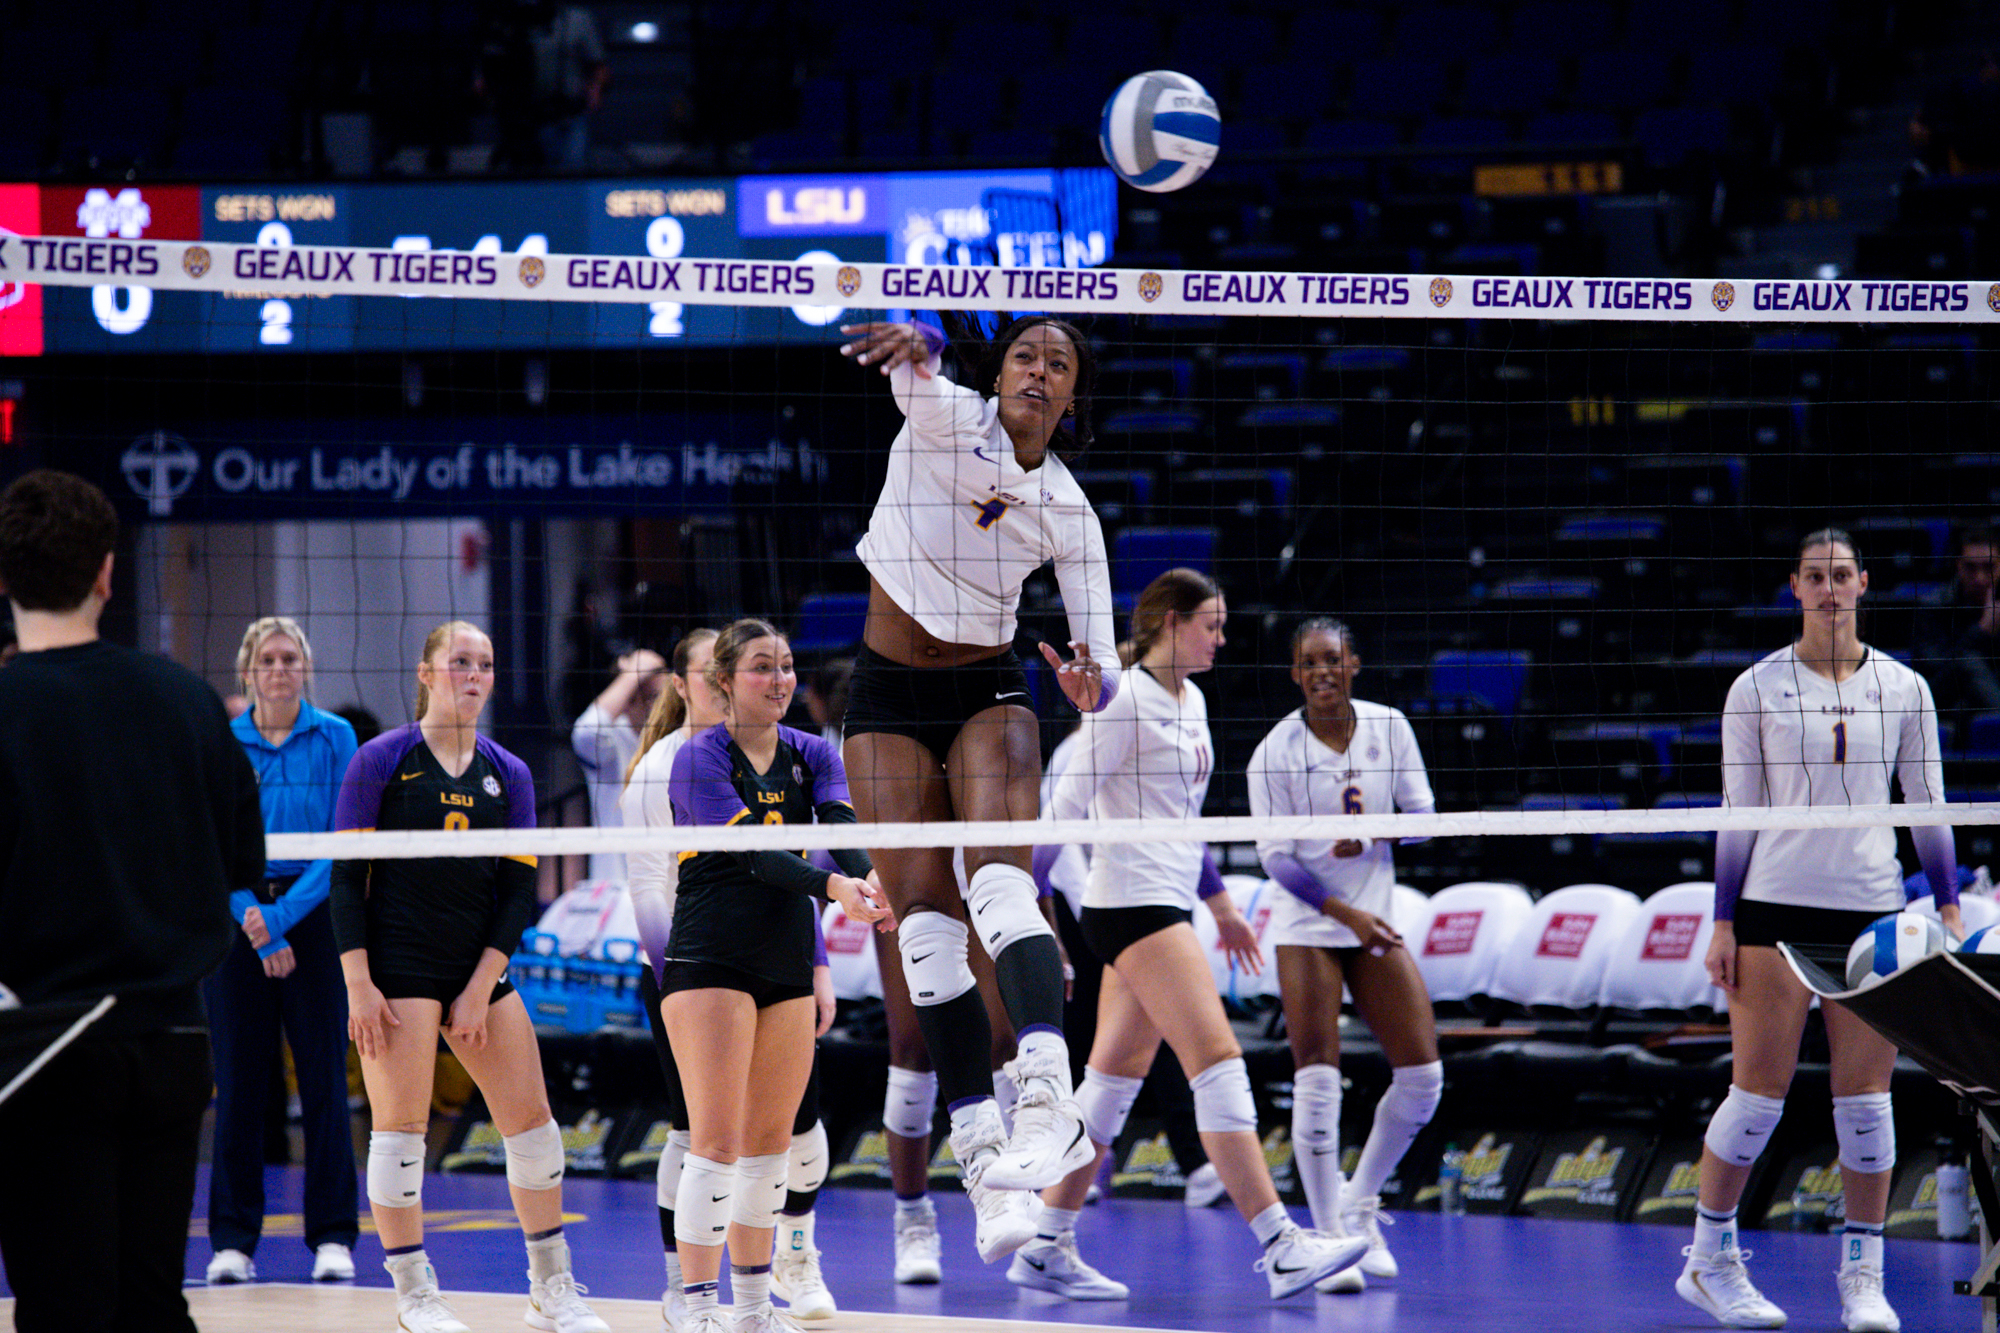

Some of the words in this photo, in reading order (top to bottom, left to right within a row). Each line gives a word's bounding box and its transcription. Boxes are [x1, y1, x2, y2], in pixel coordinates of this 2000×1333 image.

[215, 195, 274, 221] SETS
[766, 188, 866, 225] LSU
[646, 217, 684, 258] 0
[21, 240, 159, 275] TIGERS
[234, 249, 354, 283] GEAUX
[369, 252, 497, 286] TIGERS
[567, 259, 681, 292] GEAUX
[693, 263, 814, 295] TIGERS
[882, 268, 991, 299] GEAUX
[1002, 270, 1118, 300] TIGERS
[1183, 274, 1287, 304] GEAUX
[1297, 275, 1409, 305] TIGERS
[1472, 279, 1574, 308] GEAUX
[1584, 281, 1692, 310] TIGERS
[1753, 283, 1852, 311] GEAUX
[1861, 284, 1969, 311] TIGERS
[260, 300, 293, 345] 2
[212, 448, 299, 492] Our
[311, 446, 418, 500] Lady
[426, 442, 475, 489] of
[486, 442, 560, 488] the
[568, 442, 672, 488] Lake
[1832, 721, 1847, 764] 1
[1193, 745, 1209, 785] 11
[440, 791, 474, 807] LSU
[757, 790, 785, 804] LSU
